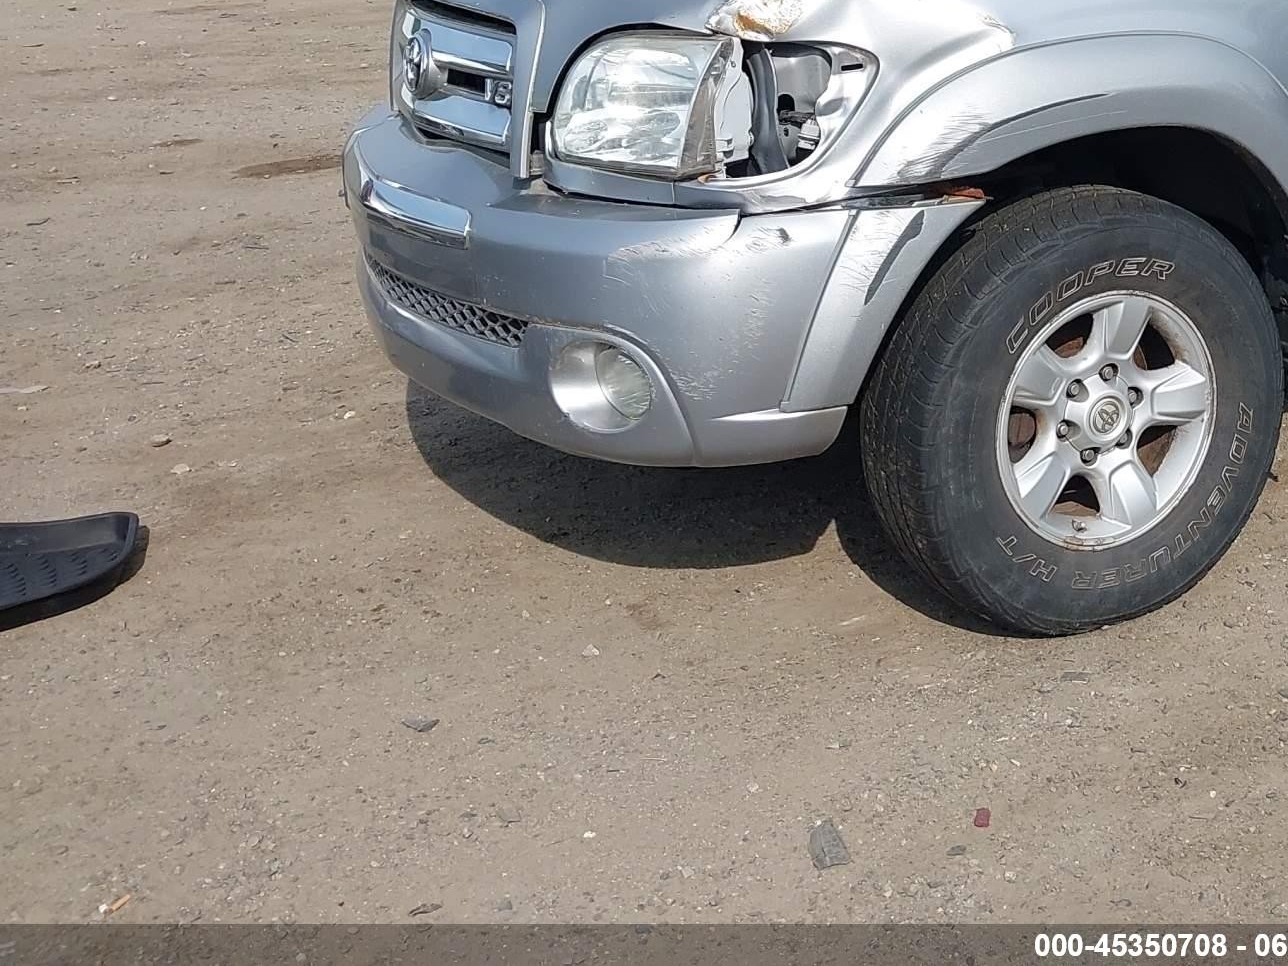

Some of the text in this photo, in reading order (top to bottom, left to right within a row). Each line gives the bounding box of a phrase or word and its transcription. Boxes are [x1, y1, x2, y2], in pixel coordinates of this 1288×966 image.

[484, 78, 512, 105] V8
[1005, 257, 1176, 354] COOPER
[996, 401, 1254, 590] ADVENTURER H/T
